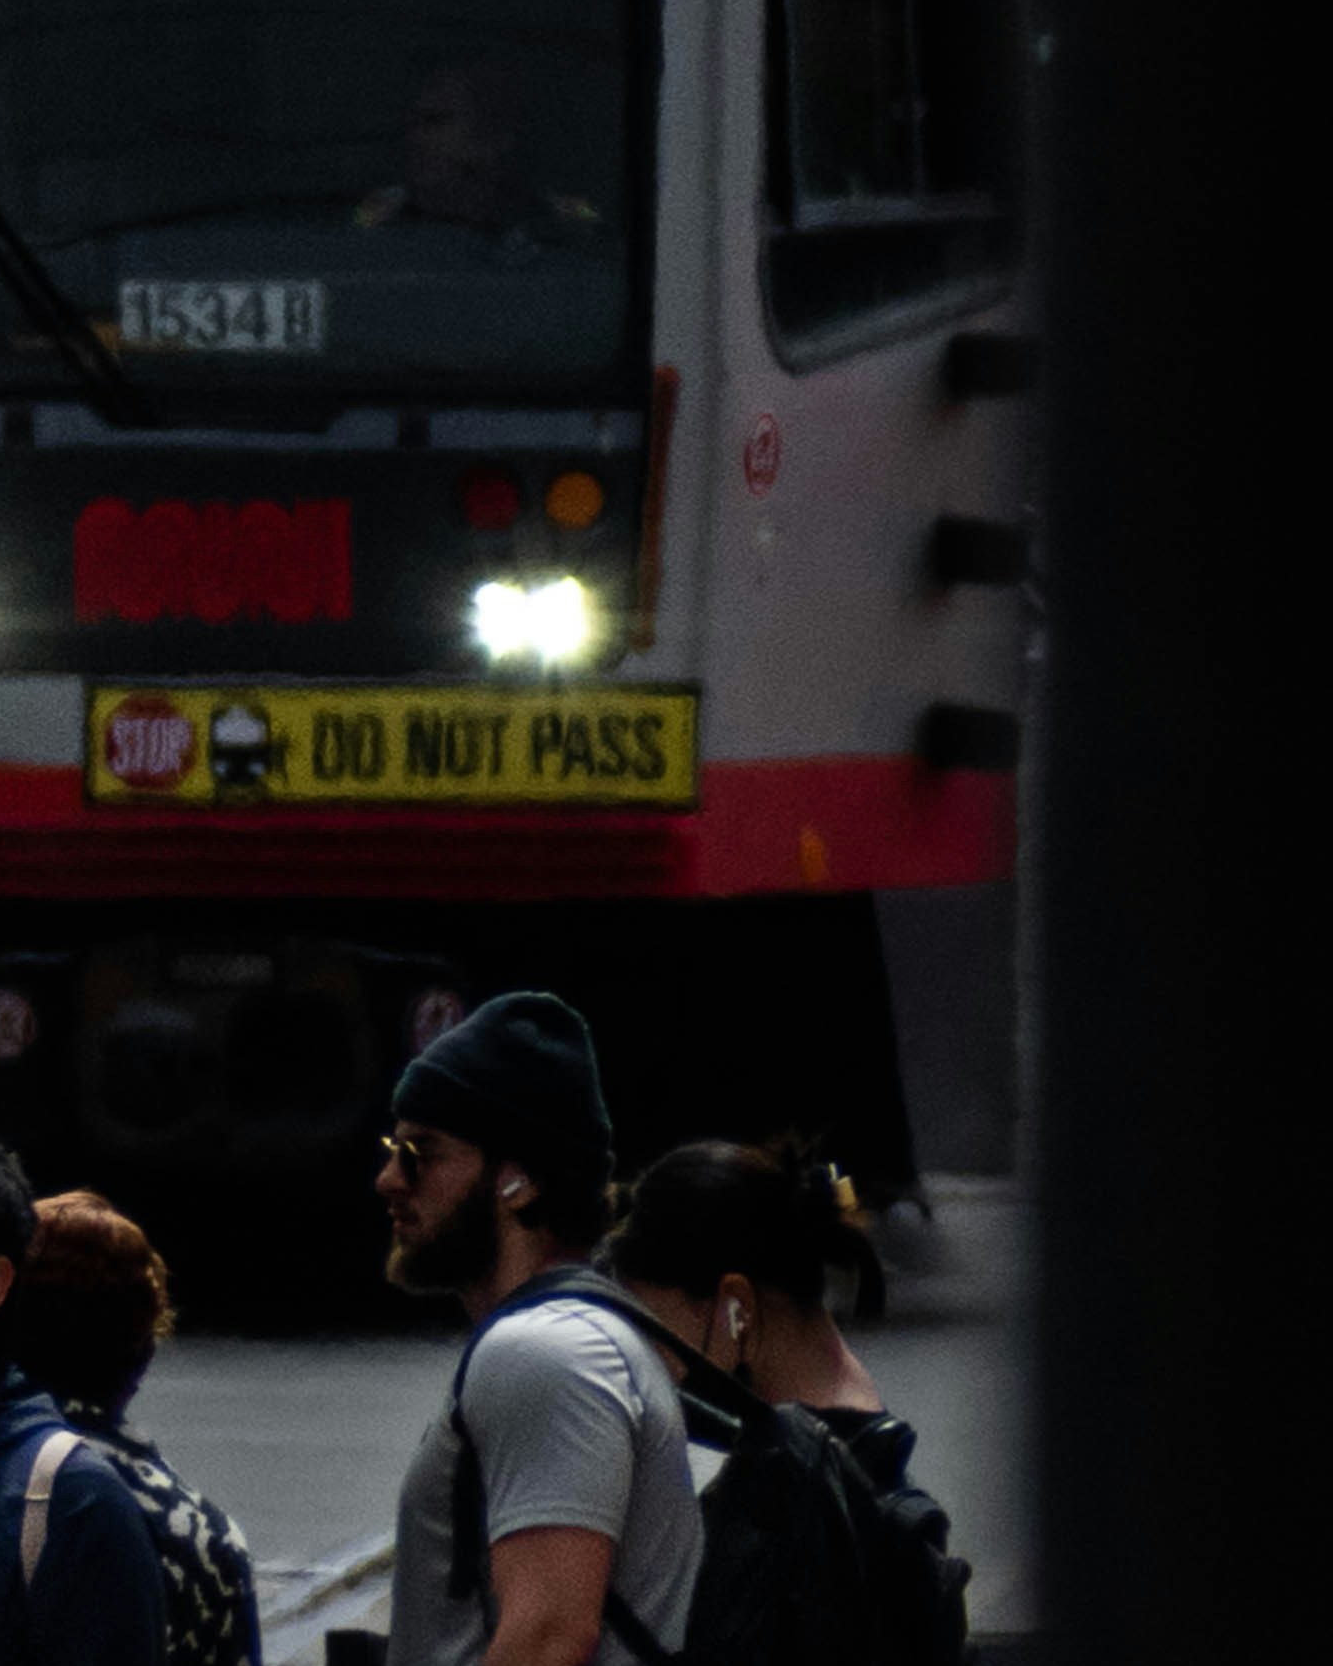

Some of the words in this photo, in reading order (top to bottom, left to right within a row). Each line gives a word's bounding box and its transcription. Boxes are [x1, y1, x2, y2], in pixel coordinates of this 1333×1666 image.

[108, 716, 194, 776] STOP
[312, 709, 383, 779] DO
[405, 708, 509, 777] NOT
[528, 712, 666, 780] PASS
